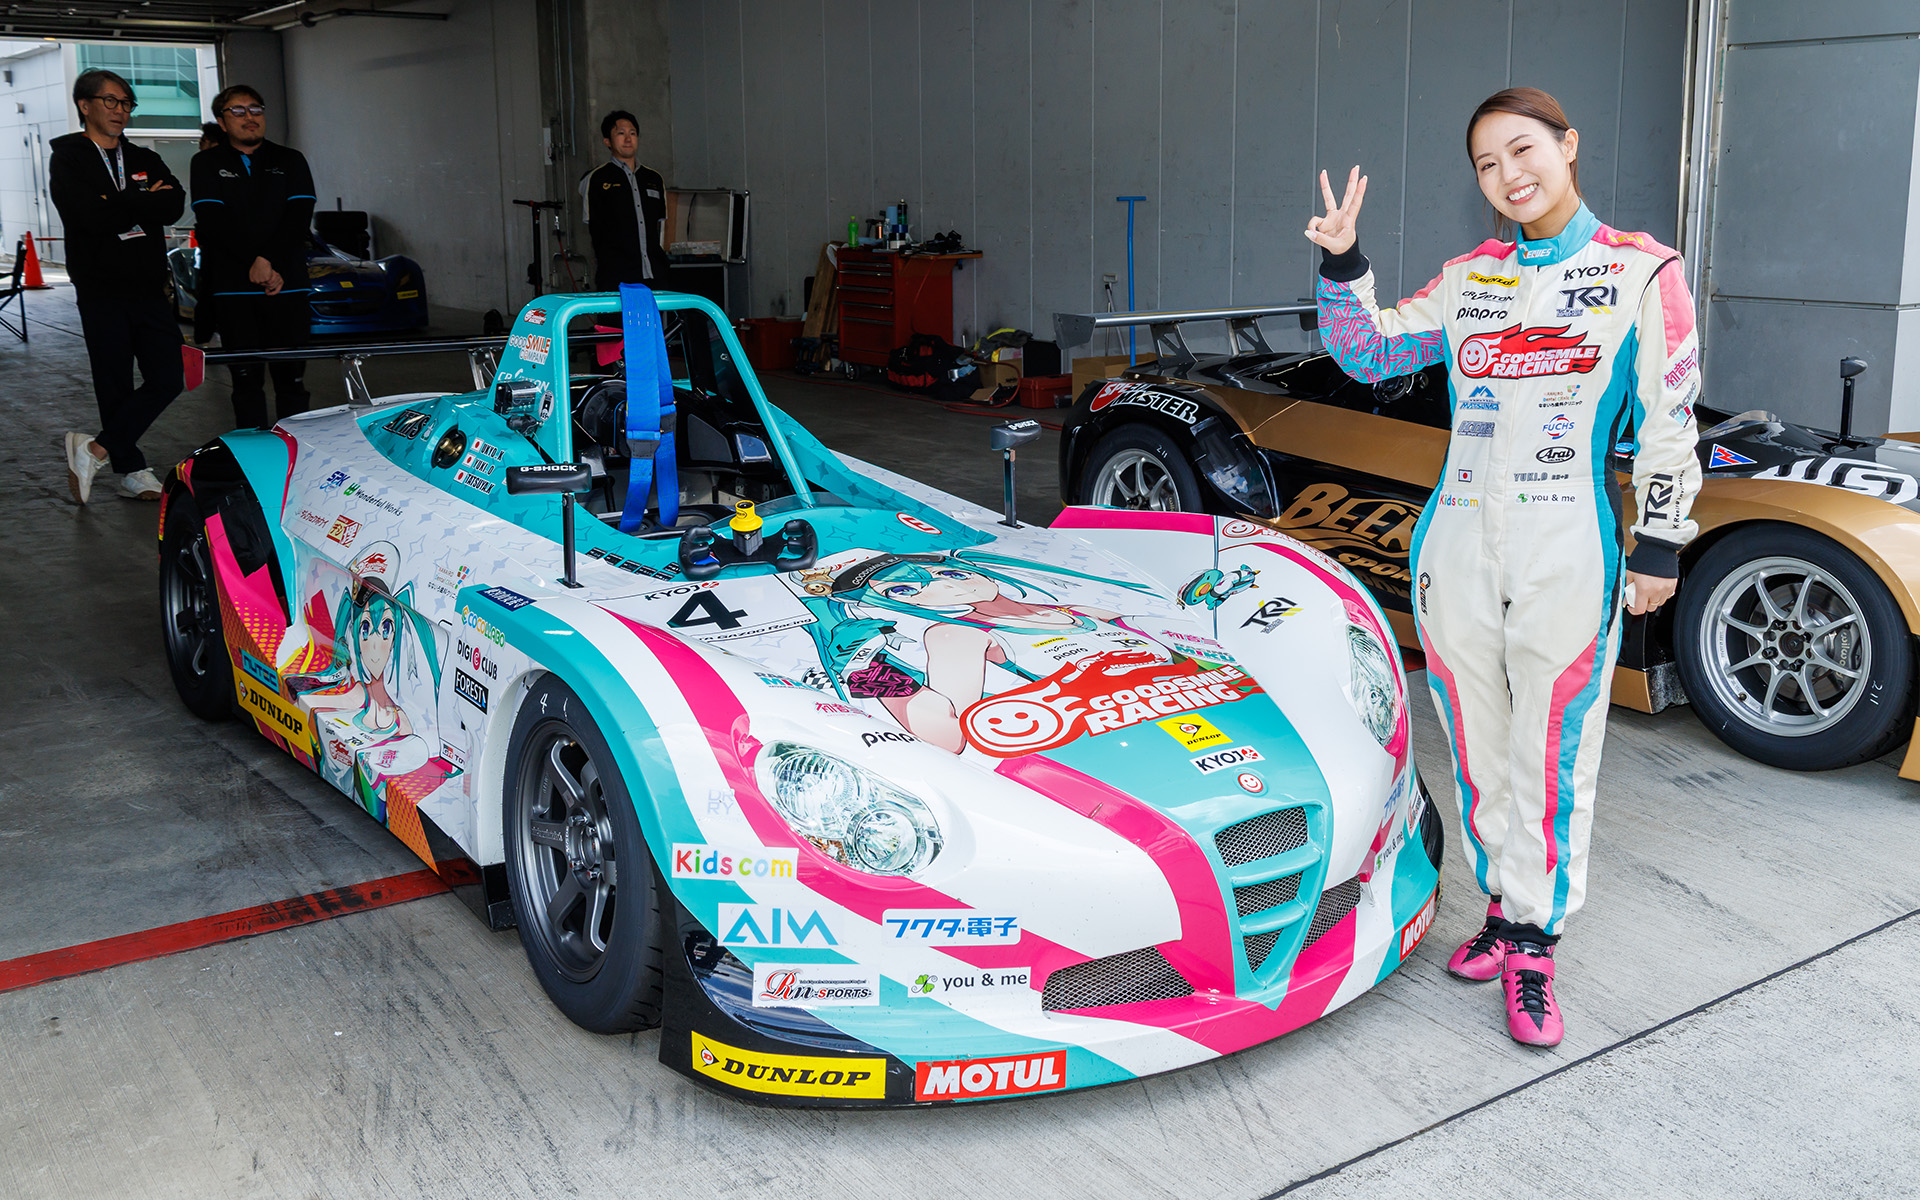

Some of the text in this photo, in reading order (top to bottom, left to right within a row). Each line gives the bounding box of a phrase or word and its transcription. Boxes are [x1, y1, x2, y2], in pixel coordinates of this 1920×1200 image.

[1477, 277, 1517, 287] DUNLOP
[1456, 307, 1508, 321] piapro
[1501, 347, 1597, 363] GOODSMILE
[1491, 359, 1571, 377] RACING
[1008, 419, 1039, 431] G-SHOCK
[1542, 421, 1575, 432] FUCHS
[1539, 448, 1571, 460] Arai
[520, 464, 578, 473] G-SHOCK
[355, 488, 403, 517] Wonderful Works
[1439, 494, 1479, 508] Kids com
[1531, 495, 1549, 503] you
[1551, 494, 1558, 502] &
[666, 589, 749, 631] 4
[768, 617, 813, 632] Racing
[457, 639, 473, 663] DIGI
[481, 655, 498, 681] CLUB
[1053, 647, 1089, 661] piapro
[1175, 645, 1236, 662] MIKU
[456, 671, 482, 708] FOREST
[1089, 666, 1245, 711] GOODSMILE
[249, 688, 303, 736] DUNLOP
[1083, 684, 1242, 735] RACING
[1186, 733, 1222, 746] DUNLOP
[1382, 844, 1392, 864] you
[676, 849, 792, 878] Kids com
[722, 907, 839, 946] AIM
[886, 917, 1018, 938] フクダ電子
[943, 974, 1028, 992] you & me
[721, 1057, 872, 1087] DUNLOP
[922, 1056, 1061, 1096] MOTUL
